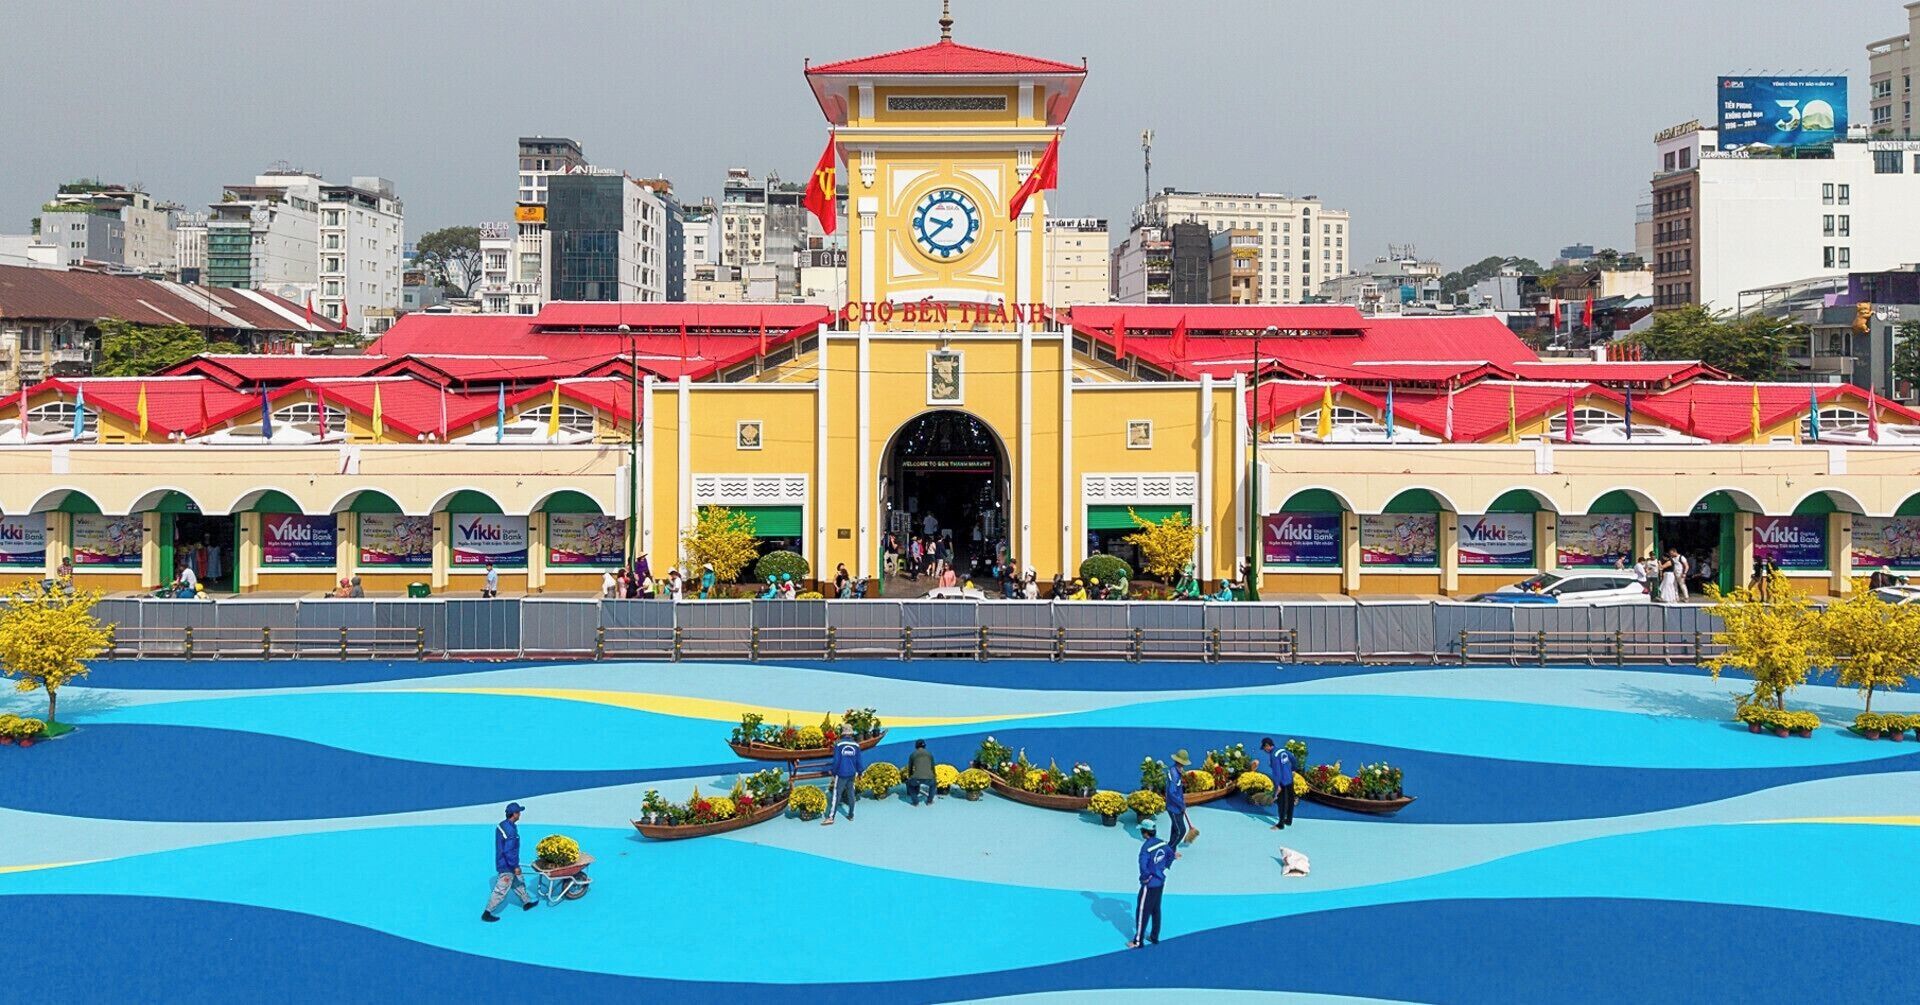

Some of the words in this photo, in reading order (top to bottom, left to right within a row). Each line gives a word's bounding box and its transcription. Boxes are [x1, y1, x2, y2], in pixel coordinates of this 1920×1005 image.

[845, 299, 894, 325] CHỢ
[902, 295, 948, 323] BẾN
[958, 297, 1046, 324] THÀNH
[268, 516, 312, 540] Vikki
[458, 516, 501, 540] Vikki
[1268, 516, 1312, 540] Vikki
[1462, 517, 1505, 541] Vikki
[1755, 519, 1799, 543] Vikki
